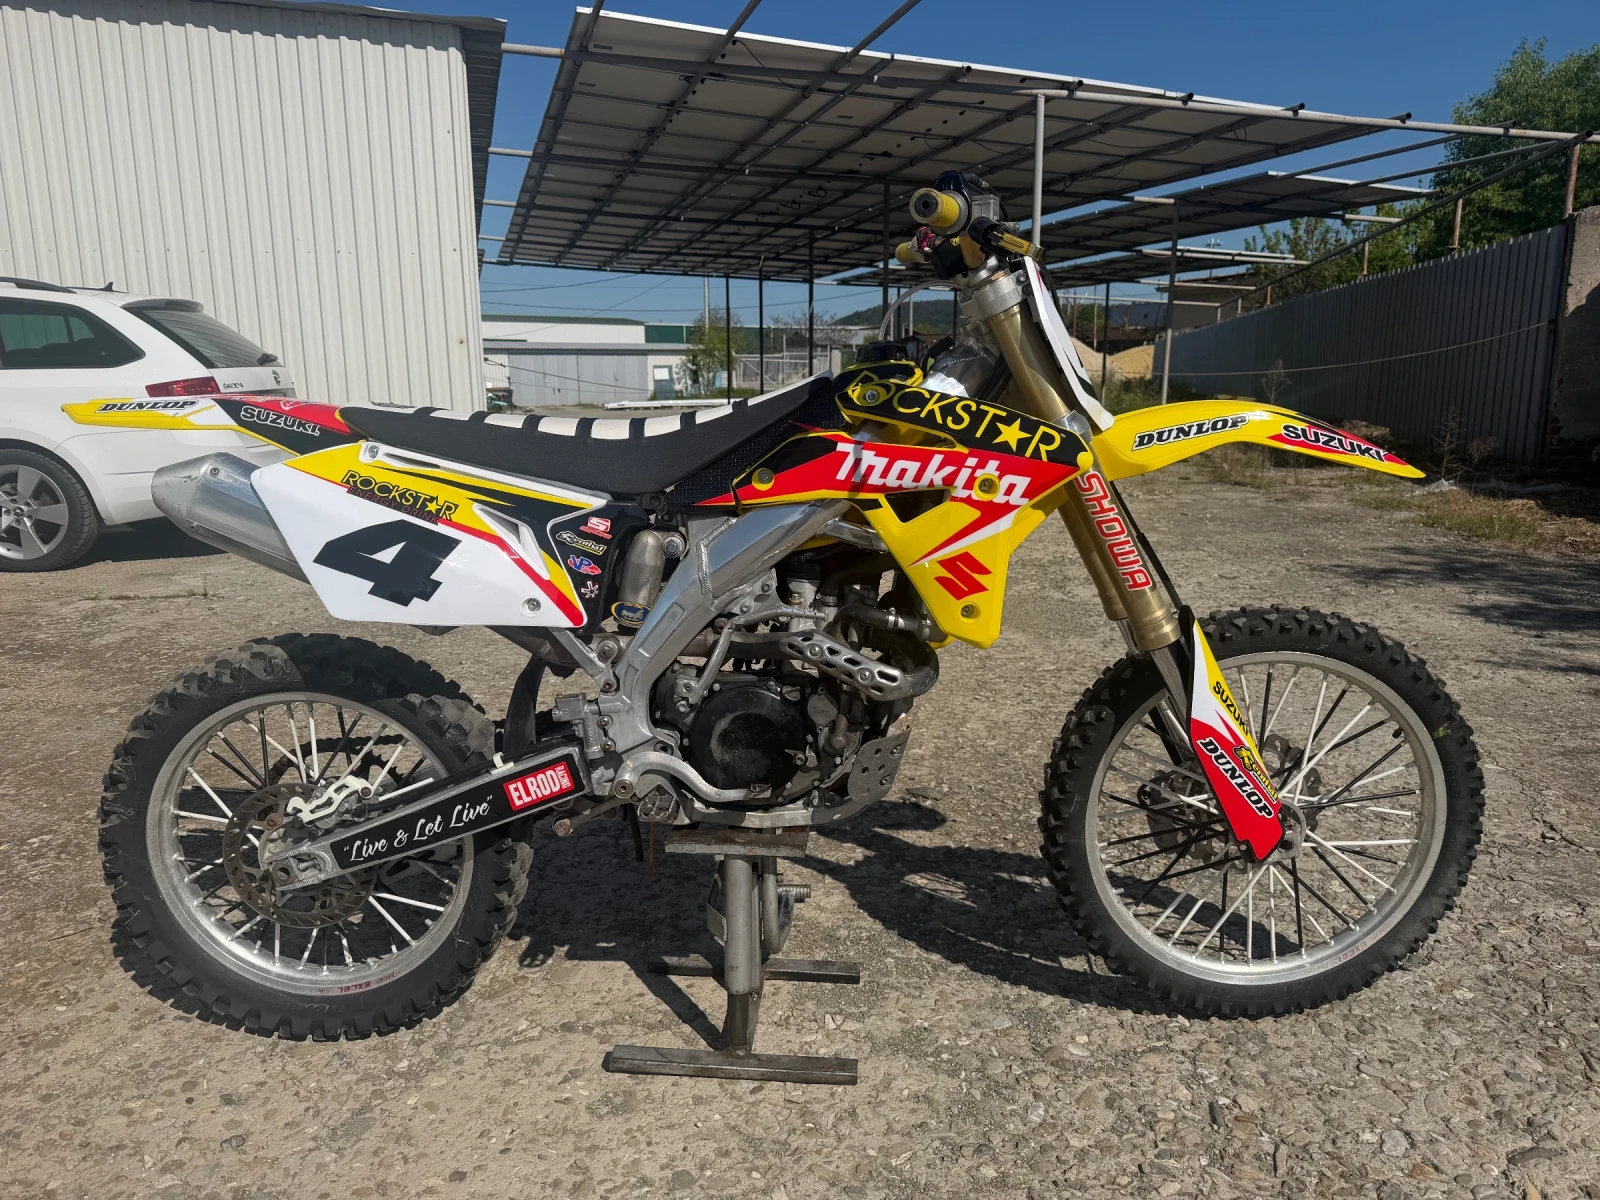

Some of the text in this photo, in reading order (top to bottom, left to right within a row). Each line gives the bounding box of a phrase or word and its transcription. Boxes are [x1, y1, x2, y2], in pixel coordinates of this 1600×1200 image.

[95, 400, 199, 413] DUNLOP
[240, 405, 318, 436] SUZUKI
[1134, 414, 1248, 449] DUNLOP
[1281, 423, 1387, 462] SUZUKI
[347, 486, 439, 525] ENERGY DRINK
[1074, 471, 1153, 591] SHOWA
[313, 519, 462, 607] 4
[1213, 681, 1249, 735] SUZUKI
[508, 770, 560, 806] ELROD
[555, 766, 571, 789] RACING
[1196, 737, 1273, 818] DUNLOP
[394, 830, 408, 847] &
[413, 818, 443, 841] Let
[1338, 940, 1369, 962] EXCEL
[337, 981, 371, 993] EXCEL
